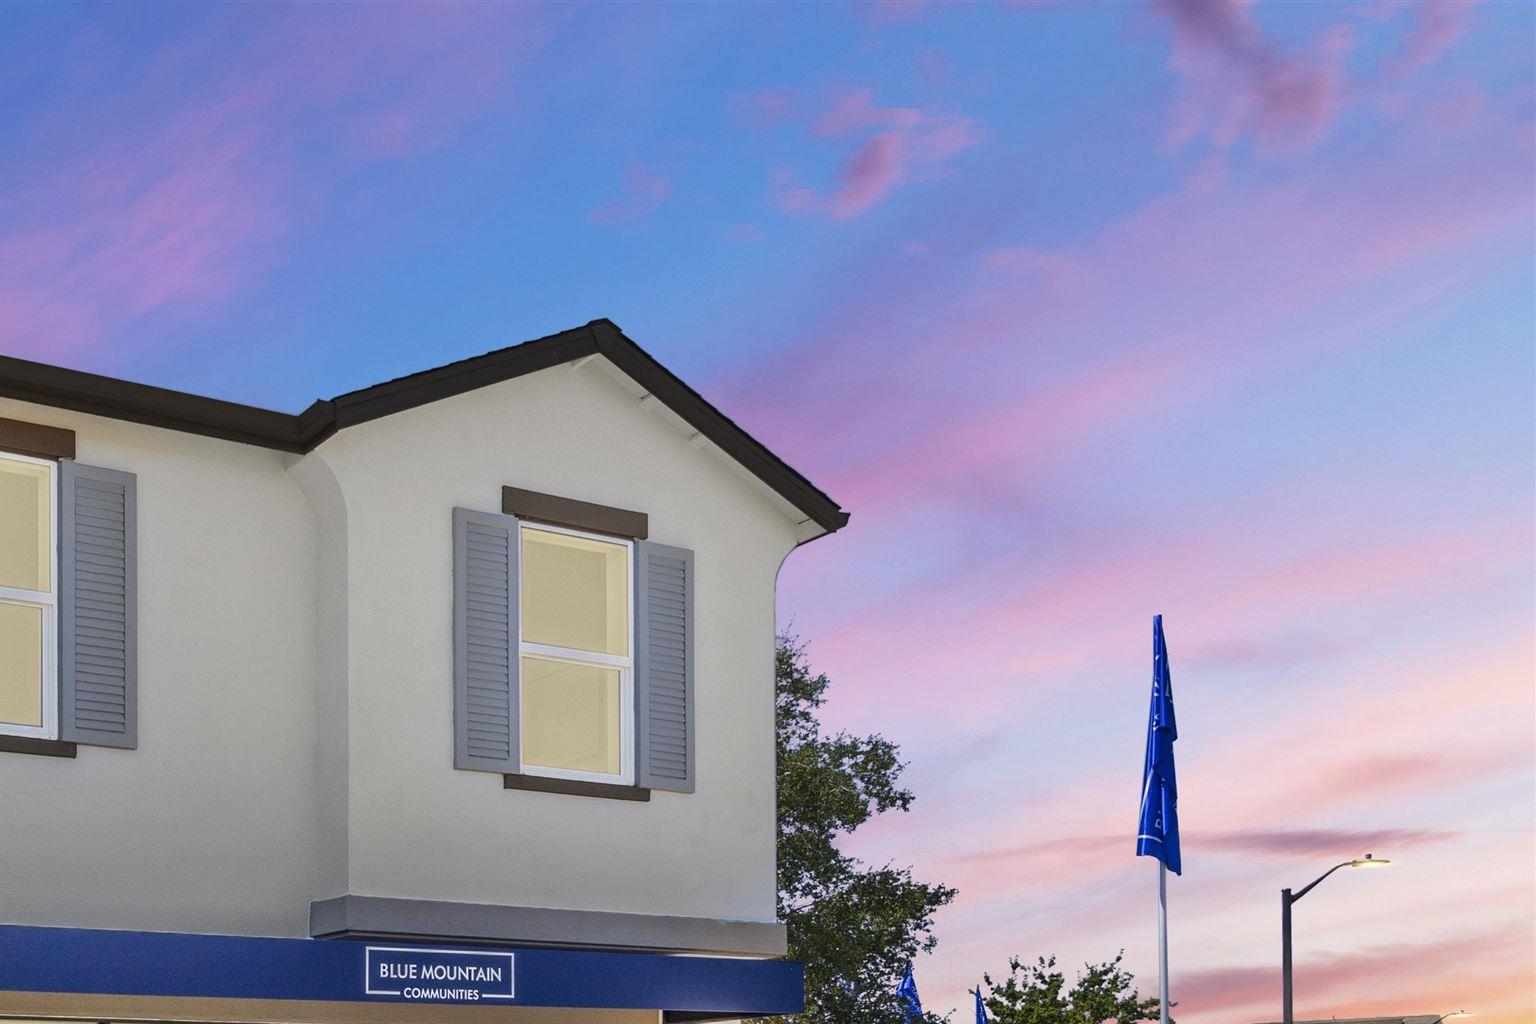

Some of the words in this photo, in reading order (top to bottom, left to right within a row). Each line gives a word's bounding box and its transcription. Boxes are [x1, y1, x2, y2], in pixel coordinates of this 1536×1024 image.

[380, 963, 417, 979] BLUE
[421, 965, 502, 982] MOUNTAIN
[404, 987, 479, 1000] COMMUNITIES
